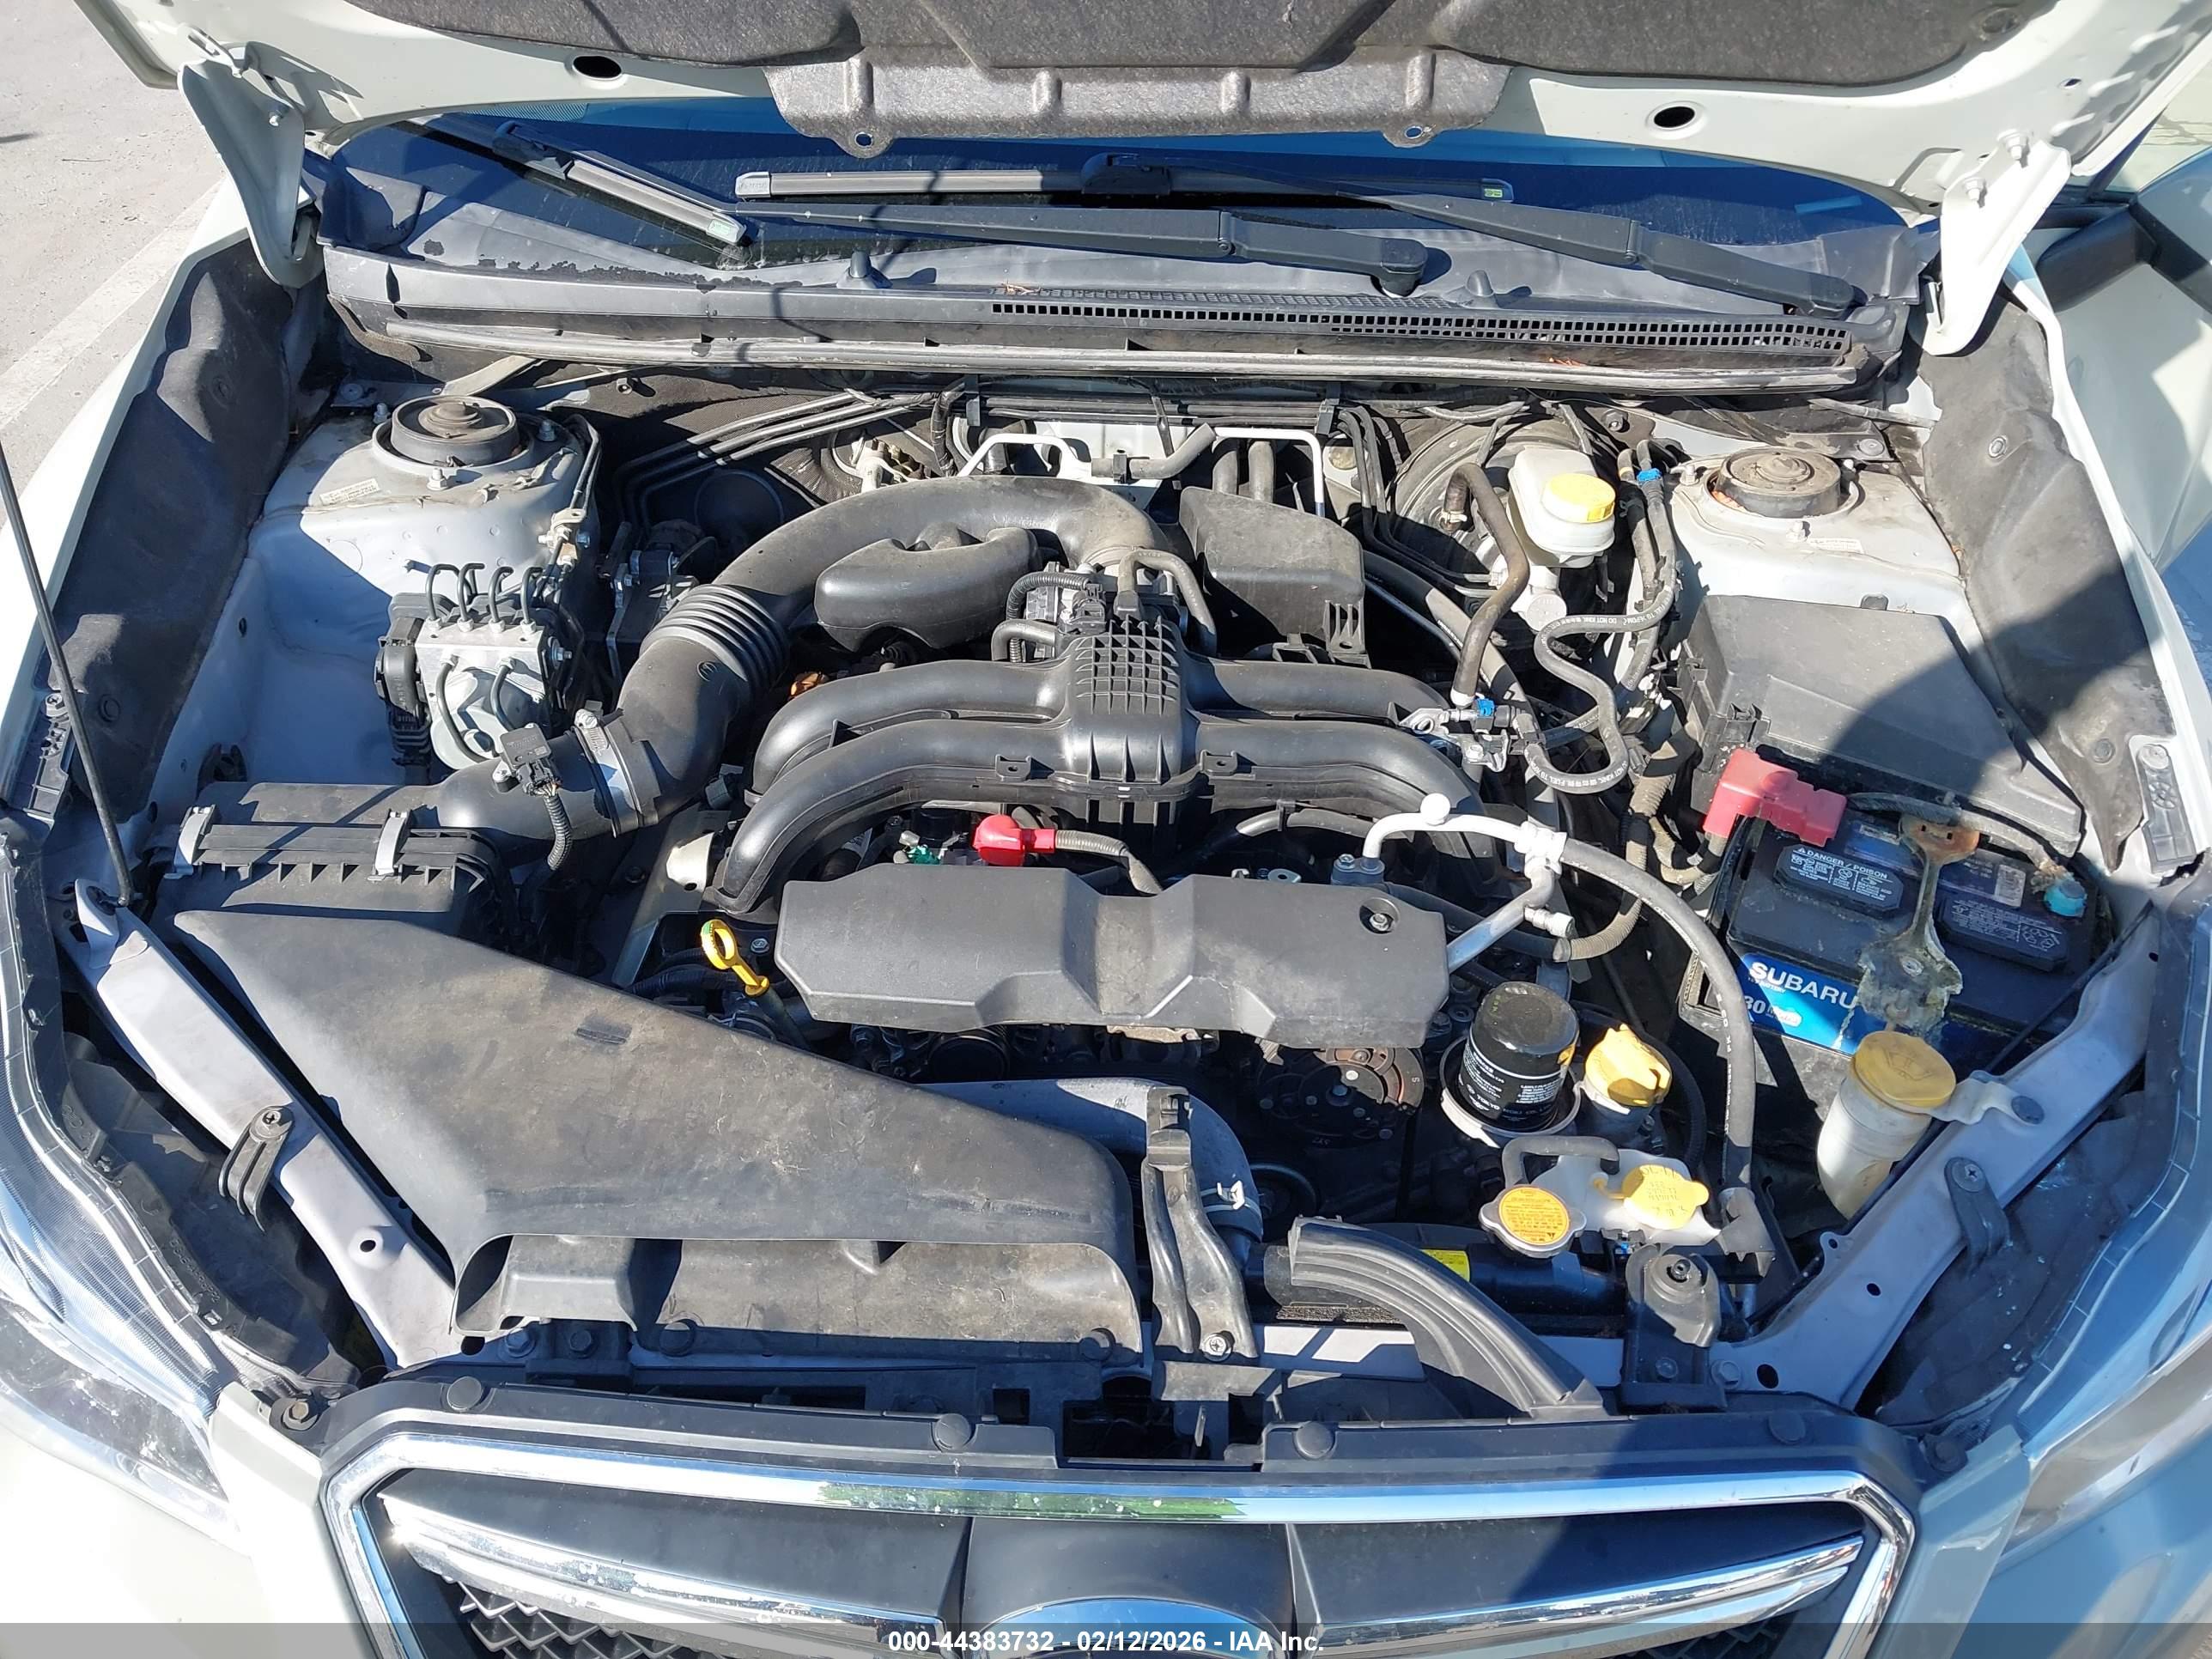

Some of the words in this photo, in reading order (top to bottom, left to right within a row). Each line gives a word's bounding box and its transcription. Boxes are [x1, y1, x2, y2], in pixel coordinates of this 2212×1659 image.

[1806, 850, 1844, 866] DANGER
[1853, 865, 1888, 879] POISON
[1749, 962, 1858, 1009] SUBARU
